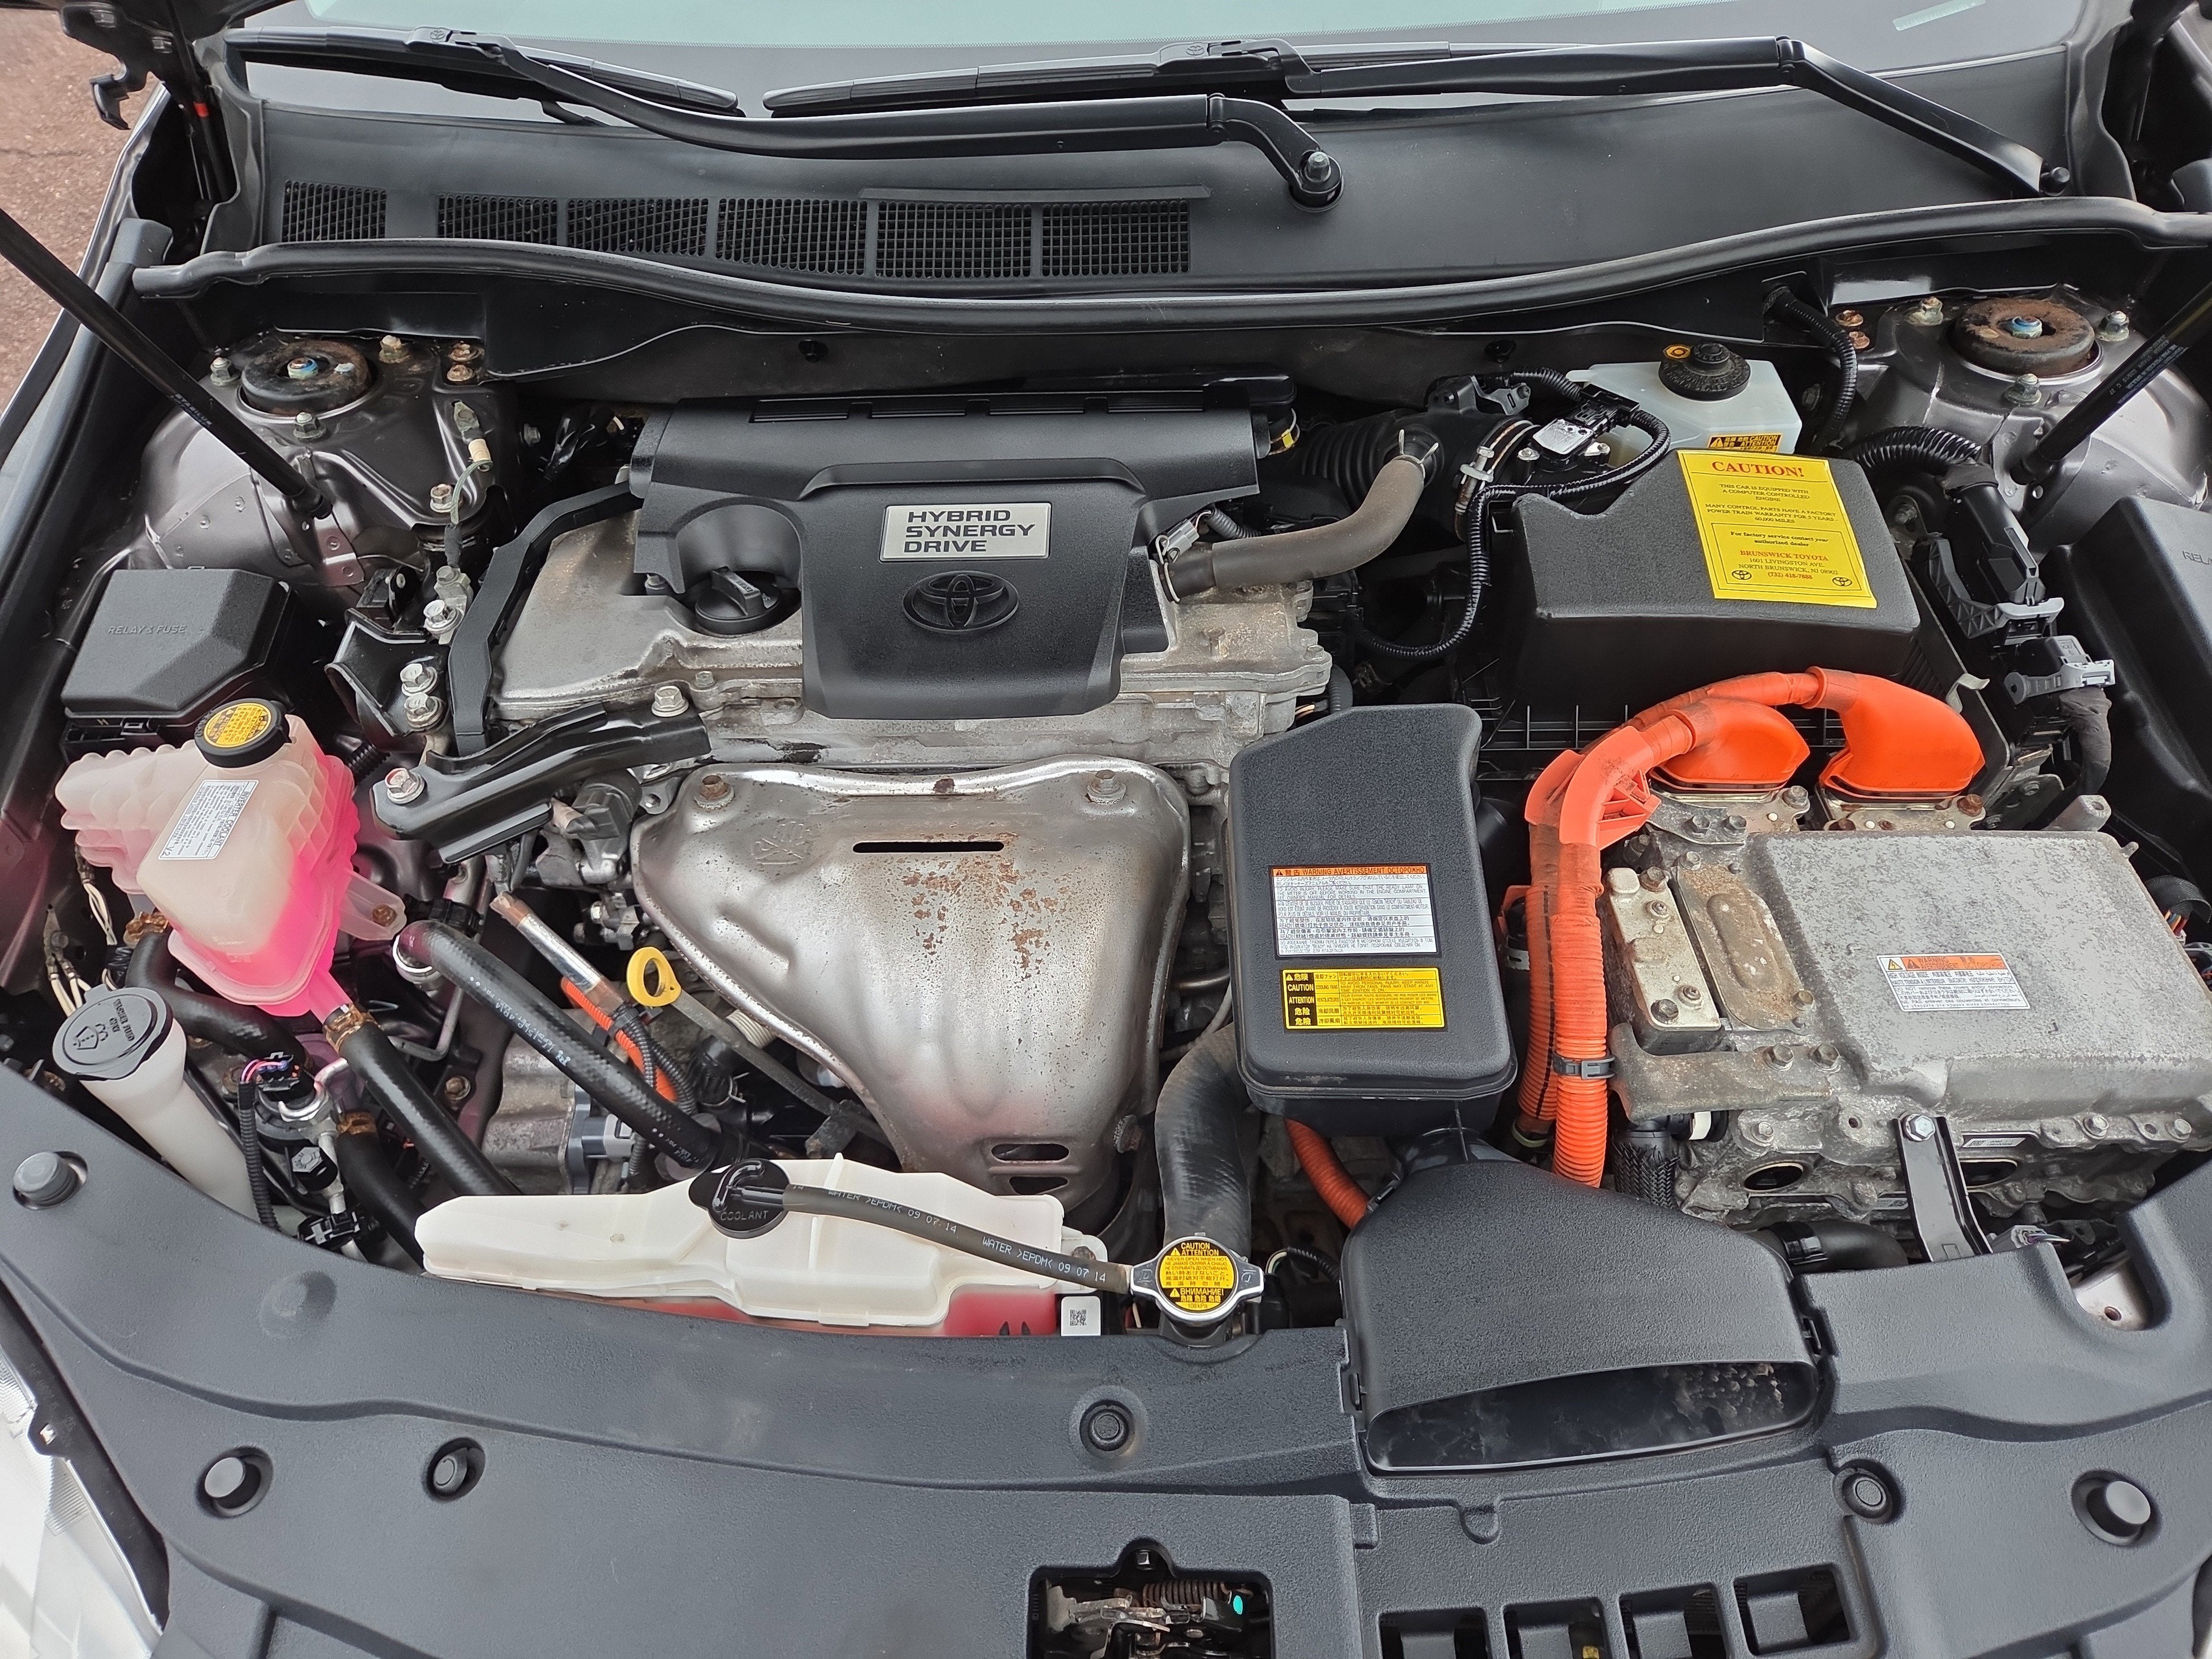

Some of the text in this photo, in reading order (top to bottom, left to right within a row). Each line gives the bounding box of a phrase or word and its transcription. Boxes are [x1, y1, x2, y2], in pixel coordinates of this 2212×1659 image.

[1712, 461, 1804, 477] CAUTION!
[908, 511, 1011, 523] HYBRID
[905, 524, 1036, 537] SYNERGY
[904, 540, 987, 552] DRIVE
[1740, 550, 1829, 561] BRUNSWICK TOYOTA
[108, 625, 188, 634] RELAY & FUSE
[214, 791, 250, 846] INVERTER COOLANT
[1288, 983, 1314, 992] CAUTION
[1289, 996, 1315, 1004] ATTENTION
[721, 1210, 769, 1221] COOLANT
[828, 1189, 957, 1234] WATER >EPDM< 09 07 14
[982, 1236, 1105, 1283] WATER >EPDM< 09 07 14
